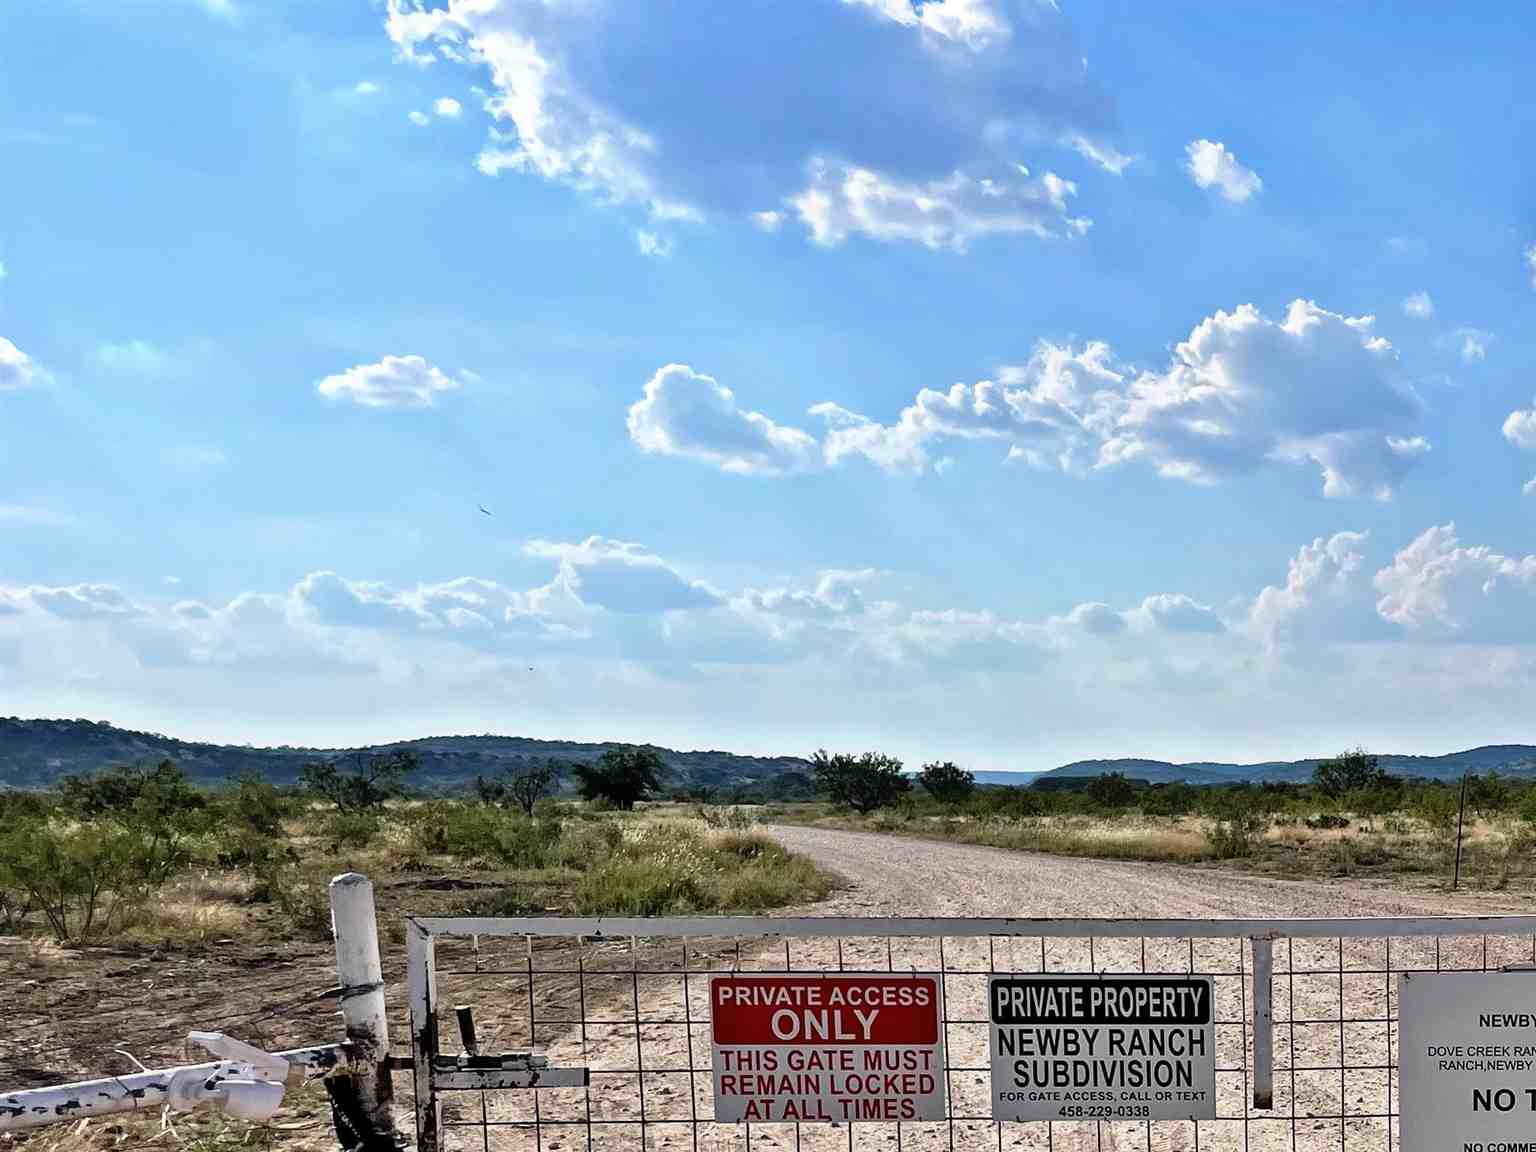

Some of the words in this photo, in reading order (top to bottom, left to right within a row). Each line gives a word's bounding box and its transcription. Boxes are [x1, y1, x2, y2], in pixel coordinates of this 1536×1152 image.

[718, 986, 822, 1006] PRIVATE
[829, 986, 929, 1006] ACCESS
[997, 986, 1084, 1018] PRIVATE
[1090, 986, 1203, 1018] PROPERTY
[771, 1008, 880, 1041] ONLY
[999, 1028, 1099, 1056] NEWBY
[1108, 1028, 1205, 1057] RANCH
[1427, 1046, 1463, 1057] DOVE
[1467, 1046, 1510, 1057] CREEK
[720, 1050, 778, 1071] THIS
[787, 1050, 854, 1071] GATE
[864, 1050, 933, 1071] MUST
[721, 1074, 820, 1096] REMAIN
[830, 1073, 935, 1095] LOCKED
[1013, 1059, 1193, 1088] SUBDIVISION
[1000, 1091, 1025, 1101] FOR
[1028, 1091, 1060, 1101] GATE
[1065, 1091, 1117, 1102] ACCESS,
[1120, 1091, 1151, 1101] CALL
[1154, 1091, 1172, 1101] OR
[1176, 1091, 1206, 1101] TEXT
[1473, 1089, 1516, 1112] NO
[743, 1100, 776, 1120] AT
[783, 1099, 831, 1120] ALL
[838, 1099, 915, 1120] TIMES
[1058, 1105, 1150, 1117] 458-229-0338
